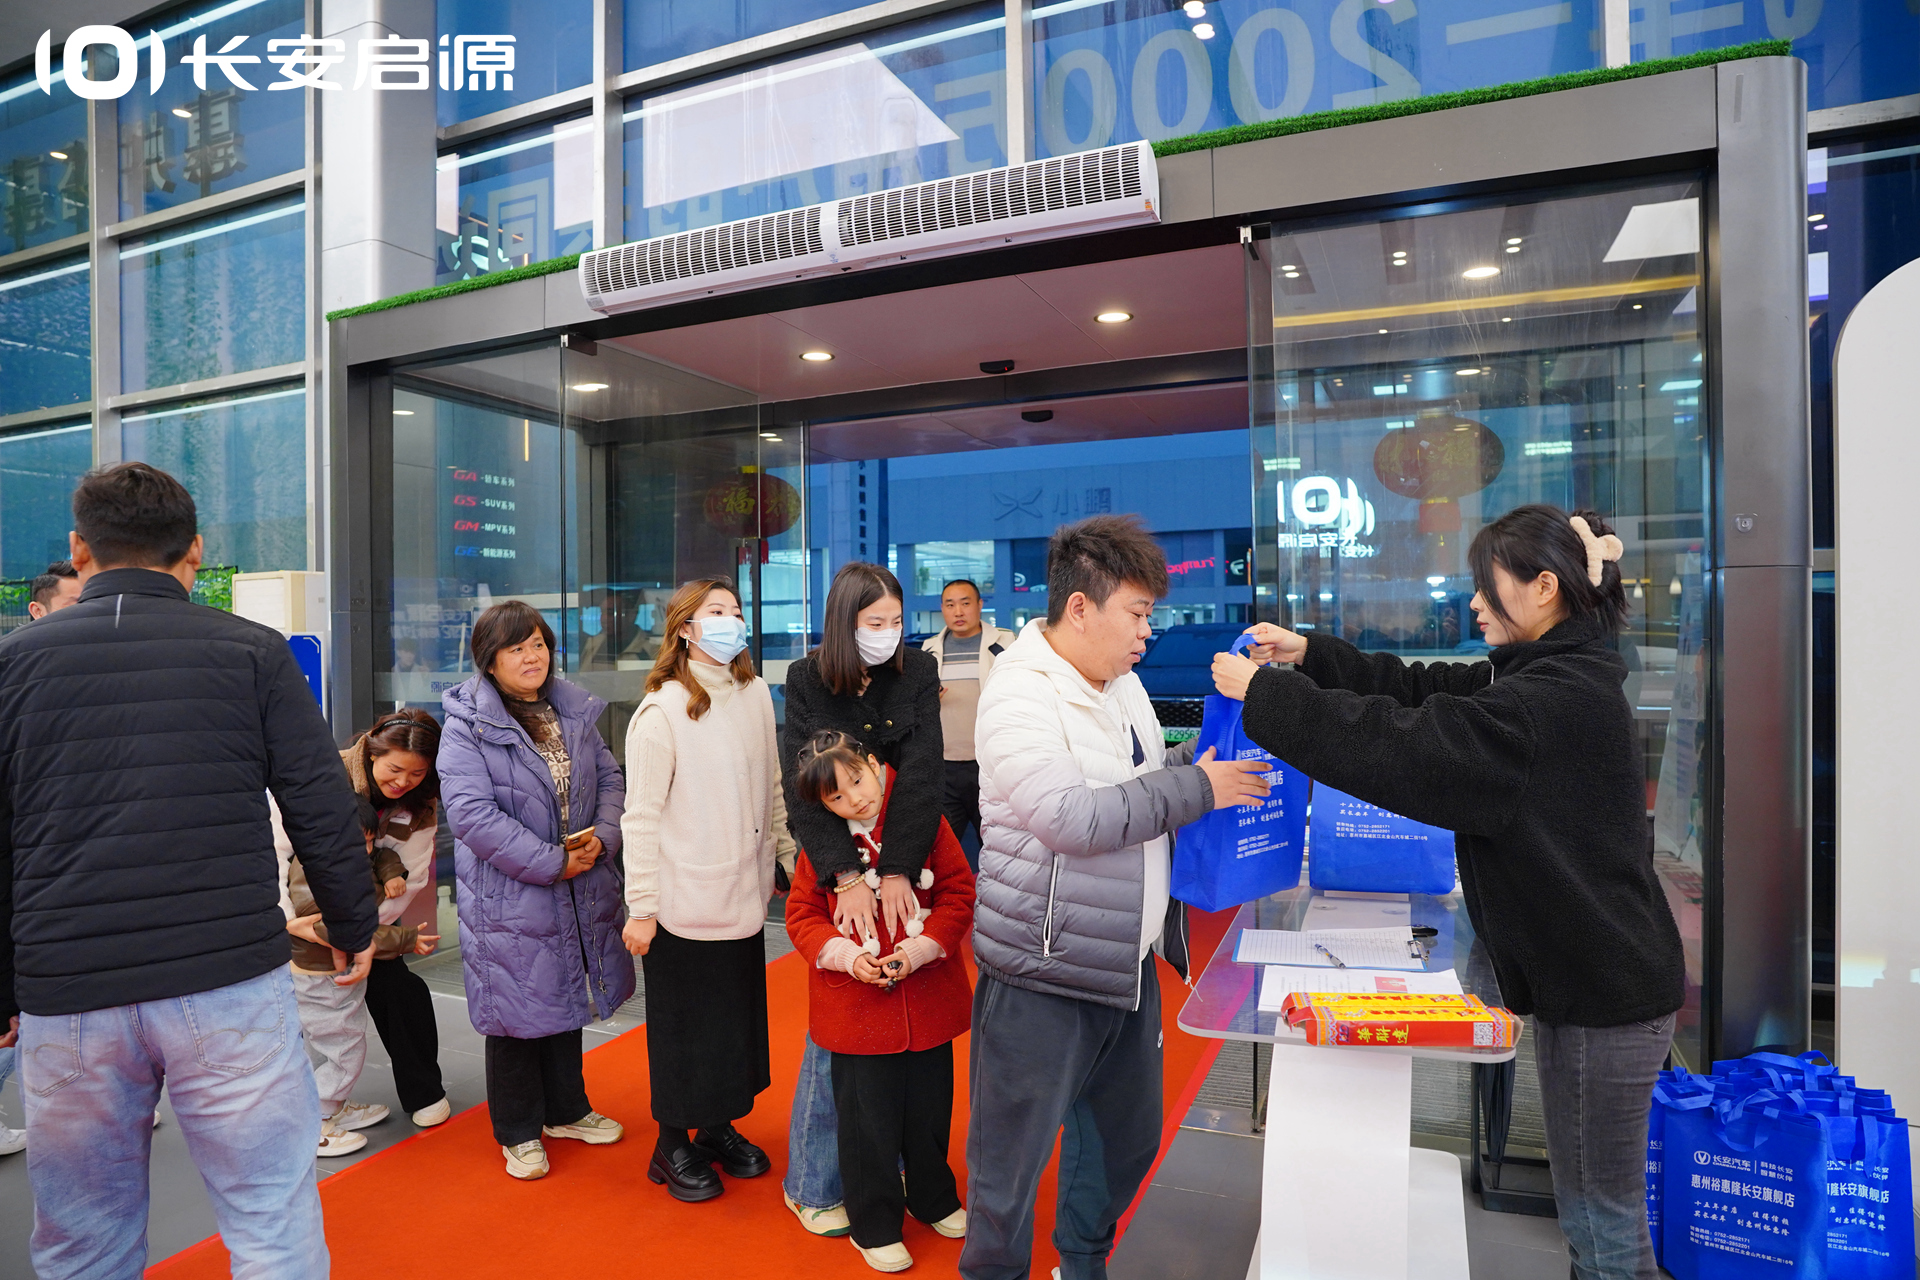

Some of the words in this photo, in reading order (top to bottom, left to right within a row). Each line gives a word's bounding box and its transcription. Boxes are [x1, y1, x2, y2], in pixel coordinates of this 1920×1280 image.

[454, 470, 477, 481] GA
[454, 494, 477, 507] GS
[722, 486, 756, 515] 福
[1052, 487, 1111, 515] 小鹏
[454, 520, 480, 532] GM
[454, 545, 480, 557] GE
[1713, 1154, 1751, 1168] 长安汽车
[1760, 1161, 1794, 1175] 科技长安
[1691, 1174, 1795, 1208] 惠州裕惠隆长安旗舰店
